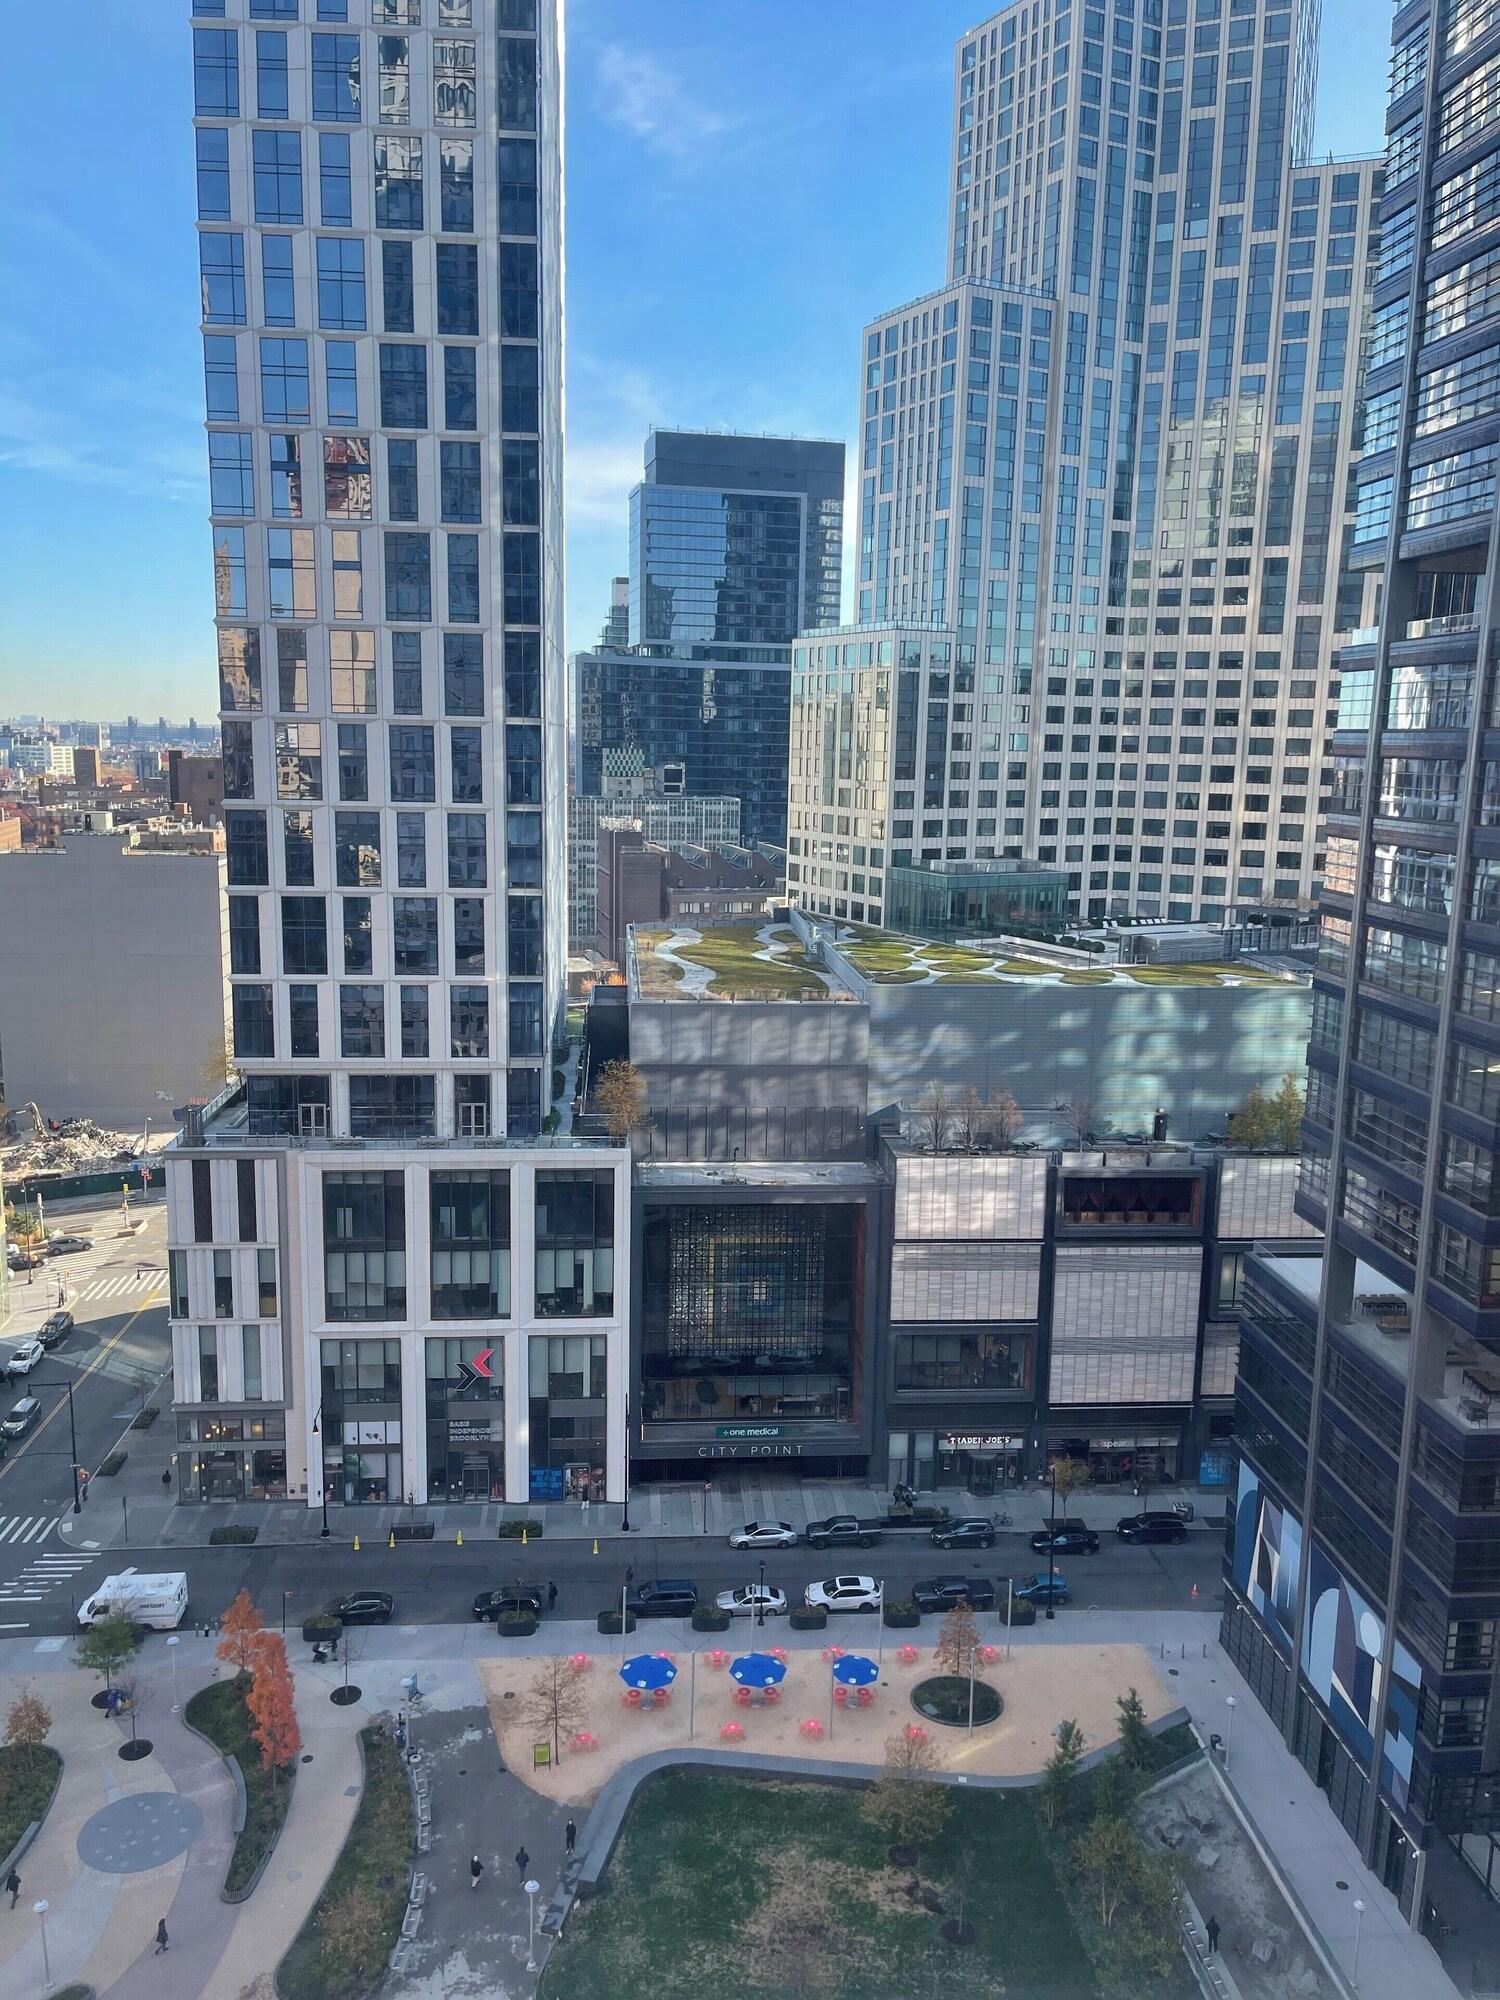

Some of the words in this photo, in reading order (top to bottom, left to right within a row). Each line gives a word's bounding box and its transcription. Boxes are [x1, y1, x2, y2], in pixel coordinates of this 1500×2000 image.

[747, 1427, 779, 1436] medical
[986, 1436, 1010, 1444] JOE'S
[1103, 1440, 1127, 1449] spear
[698, 1446, 738, 1457] CITY
[751, 1445, 803, 1456] POINT
